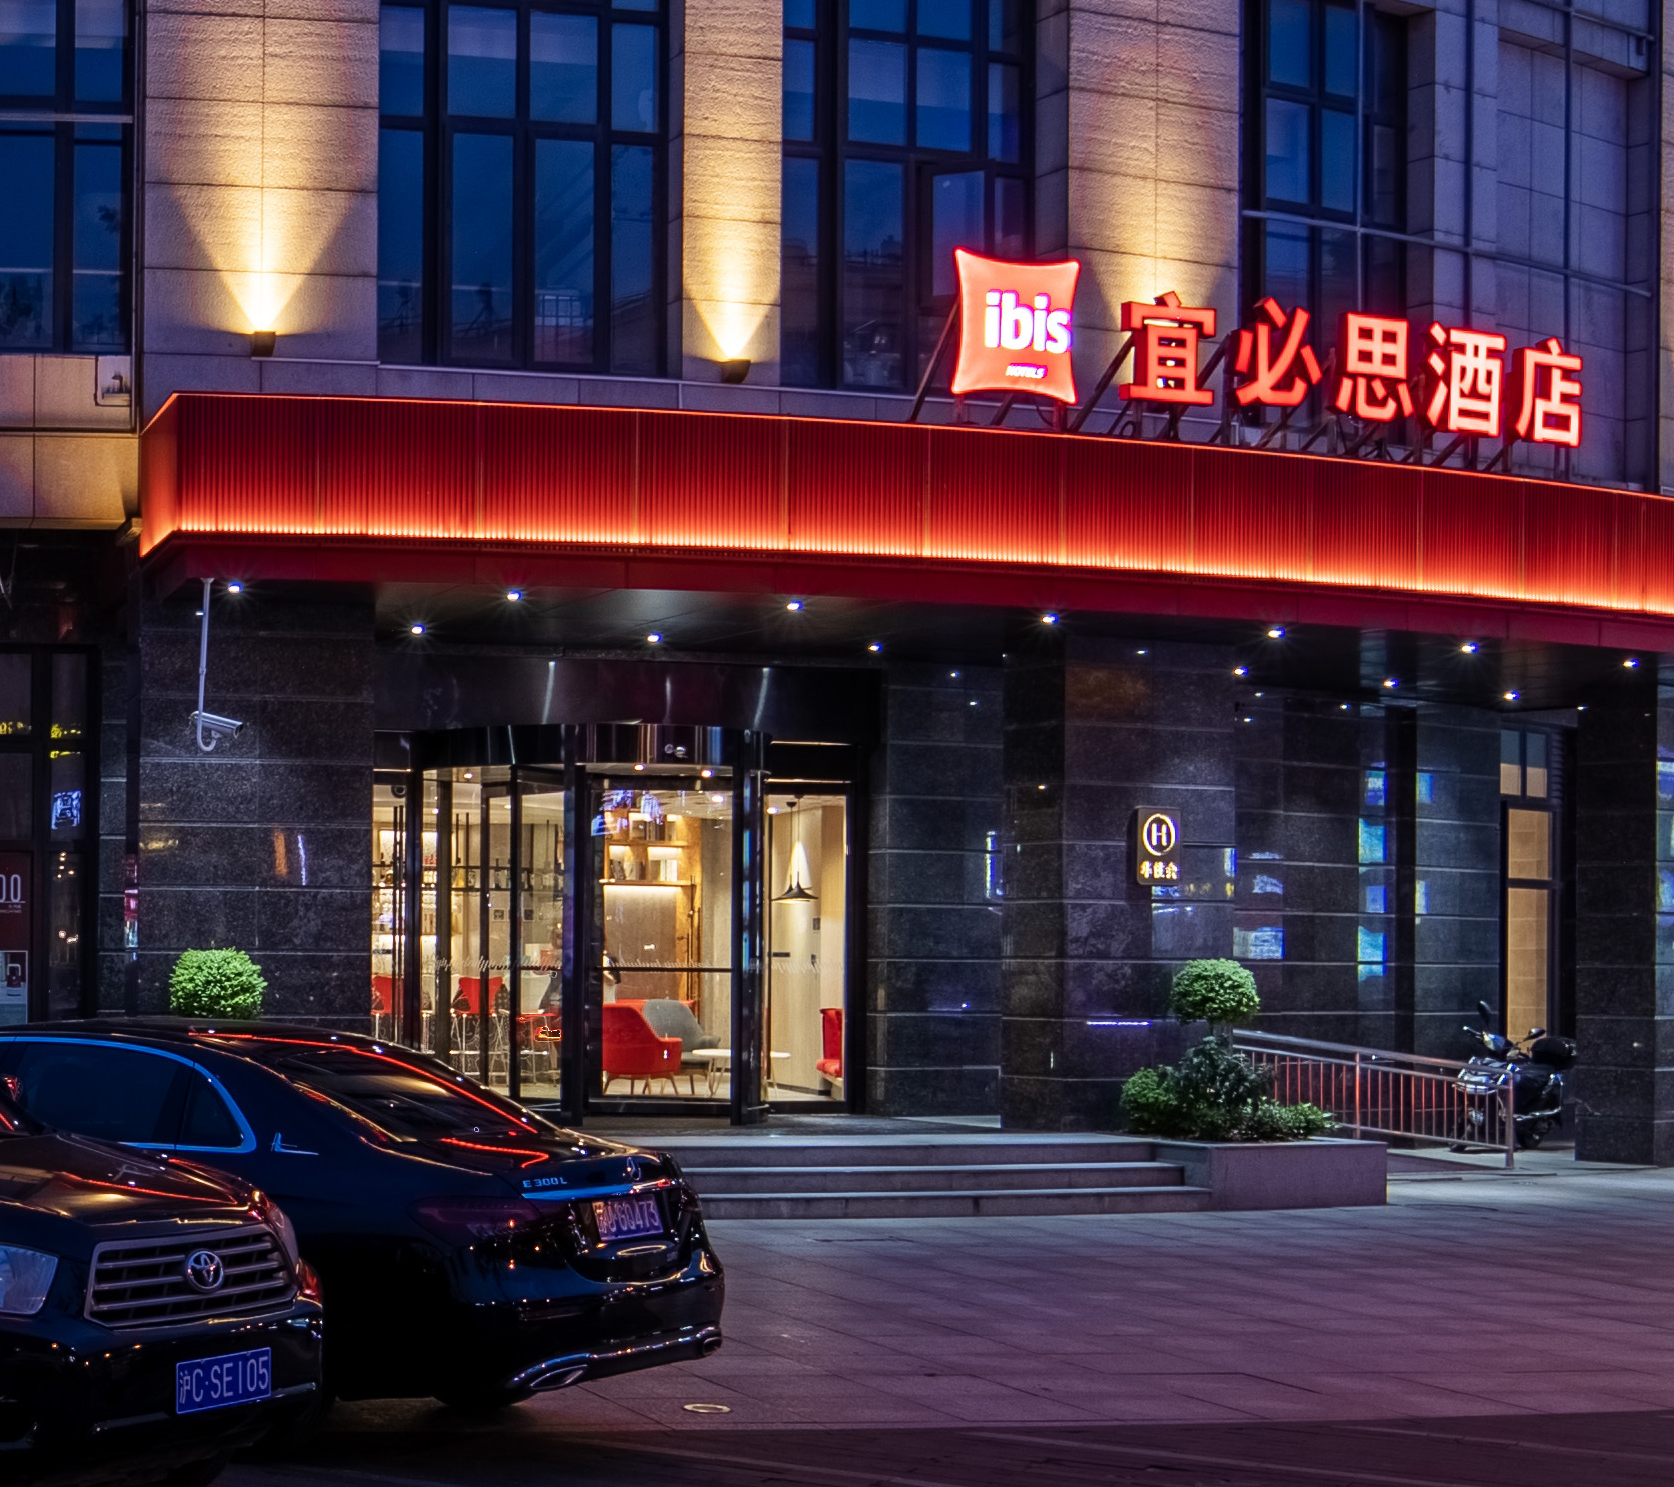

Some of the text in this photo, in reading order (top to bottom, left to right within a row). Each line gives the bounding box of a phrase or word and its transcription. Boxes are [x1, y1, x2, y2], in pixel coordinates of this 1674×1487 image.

[985, 289, 1071, 354] ibis
[1119, 291, 1583, 448] 宜必思酒店
[179, 1356, 269, 1404] 沪C·SE105
